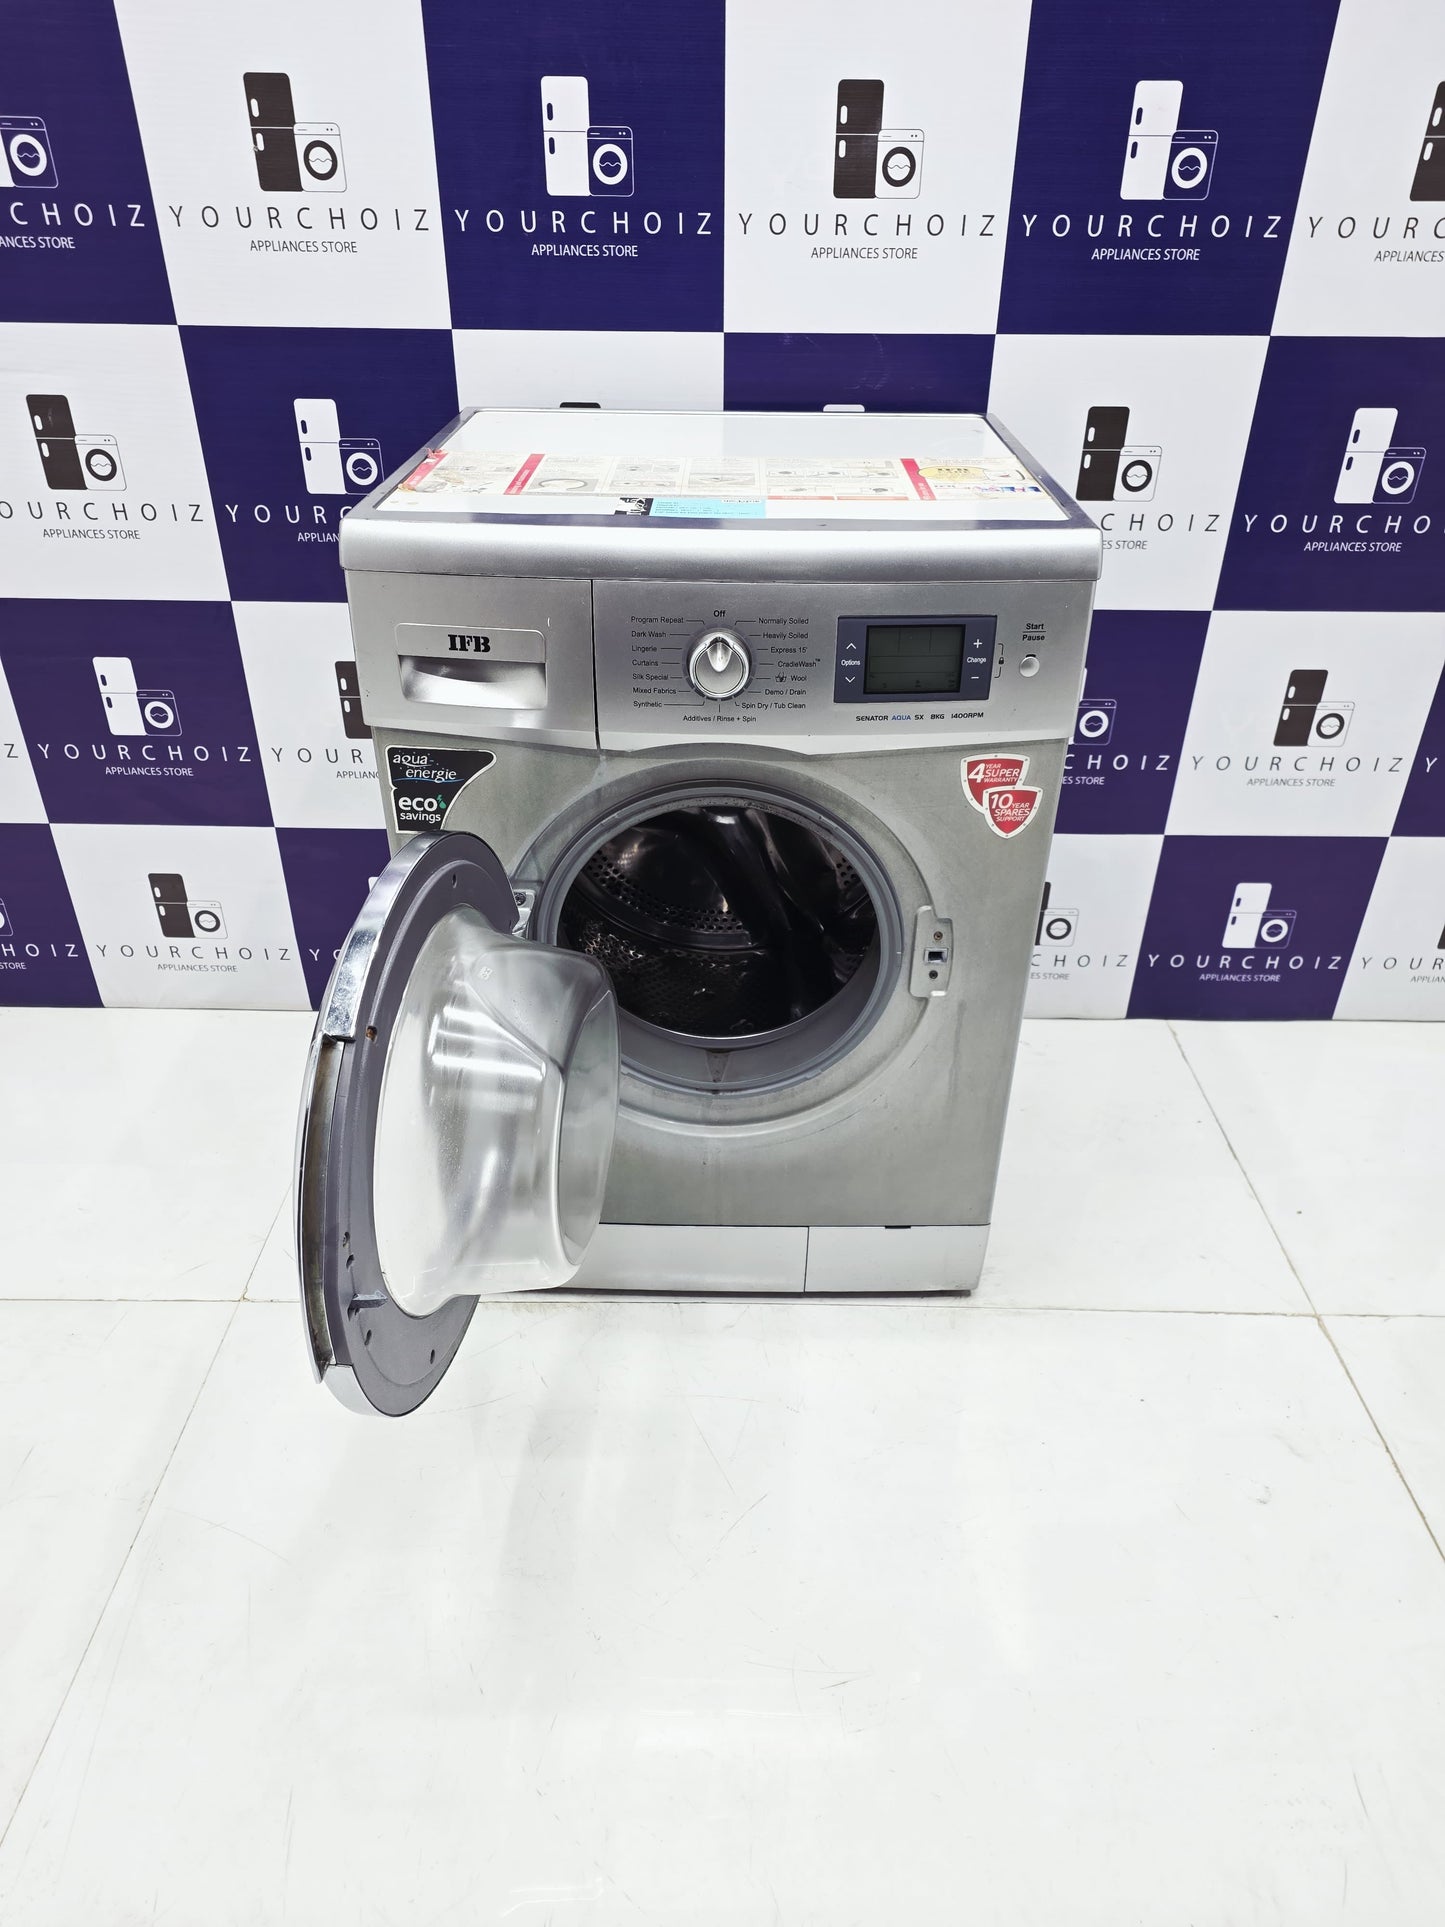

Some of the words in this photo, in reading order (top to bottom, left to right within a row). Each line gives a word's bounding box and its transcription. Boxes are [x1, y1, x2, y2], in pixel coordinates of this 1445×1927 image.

[168, 205, 430, 231] YOURCHOIZ
[454, 209, 712, 235] YOURCHOIZ
[738, 212, 995, 237] YOURCHOIZ
[1022, 214, 1282, 239] YOURCHOIZ
[37, 236, 76, 249] STORE
[250, 239, 319, 253] APPLIANCES
[321, 240, 358, 254] STORE
[531, 243, 600, 257] APPLIANCES
[602, 244, 639, 257] STORE
[810, 246, 880, 259] APPLIANCES
[881, 247, 919, 260] STORE
[1090, 247, 1161, 261] APPLIANCES
[1159, 248, 1201, 261] STORE
[1374, 250, 1445, 263] APPLIANCES
[1244, 514, 1445, 534] YOURCHO
[42, 528, 106, 539] APPLIANCES
[106, 529, 141, 540] STORE
[1114, 539, 1148, 550] STORE
[1303, 541, 1368, 552] APPLIANCES
[1368, 541, 1403, 553] STORE
[713, 609, 726, 618] Off
[630, 615, 659, 625] Program
[660, 616, 684, 625] Repeat
[758, 617, 787, 626] Normally
[788, 617, 809, 625] Soiled
[1025, 622, 1045, 630] Start
[631, 630, 647, 638] Dark
[647, 630, 667, 638] Wash
[762, 631, 787, 641] Heavily
[787, 631, 809, 639] Soiled
[1022, 634, 1046, 642] Pause
[447, 633, 491, 653] IFB
[631, 644, 658, 654] Lingerie
[770, 646, 797, 655] Express
[631, 659, 659, 667] Curtains
[840, 659, 861, 667] Options
[966, 656, 987, 665] Change
[632, 672, 645, 680] Silk
[645, 673, 669, 682] Special
[790, 674, 807, 682] Wool
[632, 686, 652, 694] Mixed
[652, 687, 677, 695] Fabrics
[764, 688, 784, 696] Demo
[789, 688, 807, 696] Drain
[633, 700, 663, 709] Synthetic
[741, 702, 756, 710] Spin
[757, 702, 769, 711] Dry
[682, 714, 712, 722] Additives
[742, 715, 757, 724] Spin
[950, 711, 984, 719] 1400RPM
[37, 743, 252, 762] YOURCHOIZ
[392, 752, 429, 767] aqua
[1192, 755, 1404, 773] YOURCHOIZ
[105, 766, 162, 776] APPLIANCES
[162, 767, 194, 777] STORE
[406, 769, 457, 783] energie
[969, 763, 985, 783] 4
[984, 768, 1020, 778] SUPER
[1074, 776, 1105, 786] STORE
[1246, 778, 1304, 787] APPLIANCES
[1305, 778, 1336, 787] STORE
[399, 797, 438, 812] eco
[990, 794, 1013, 808] 10
[994, 808, 1030, 816] SPARES
[400, 812, 441, 823] savings
[95, 944, 291, 961] YOURCHOIZ
[1148, 953, 1342, 970] YOURCHOIZ
[157, 963, 209, 972] APPLIANCES
[209, 964, 239, 973] STORE
[1042, 972, 1070, 981] STORE
[1199, 973, 1252, 982] APPLIANCES
[1253, 974, 1281, 983] STORE
